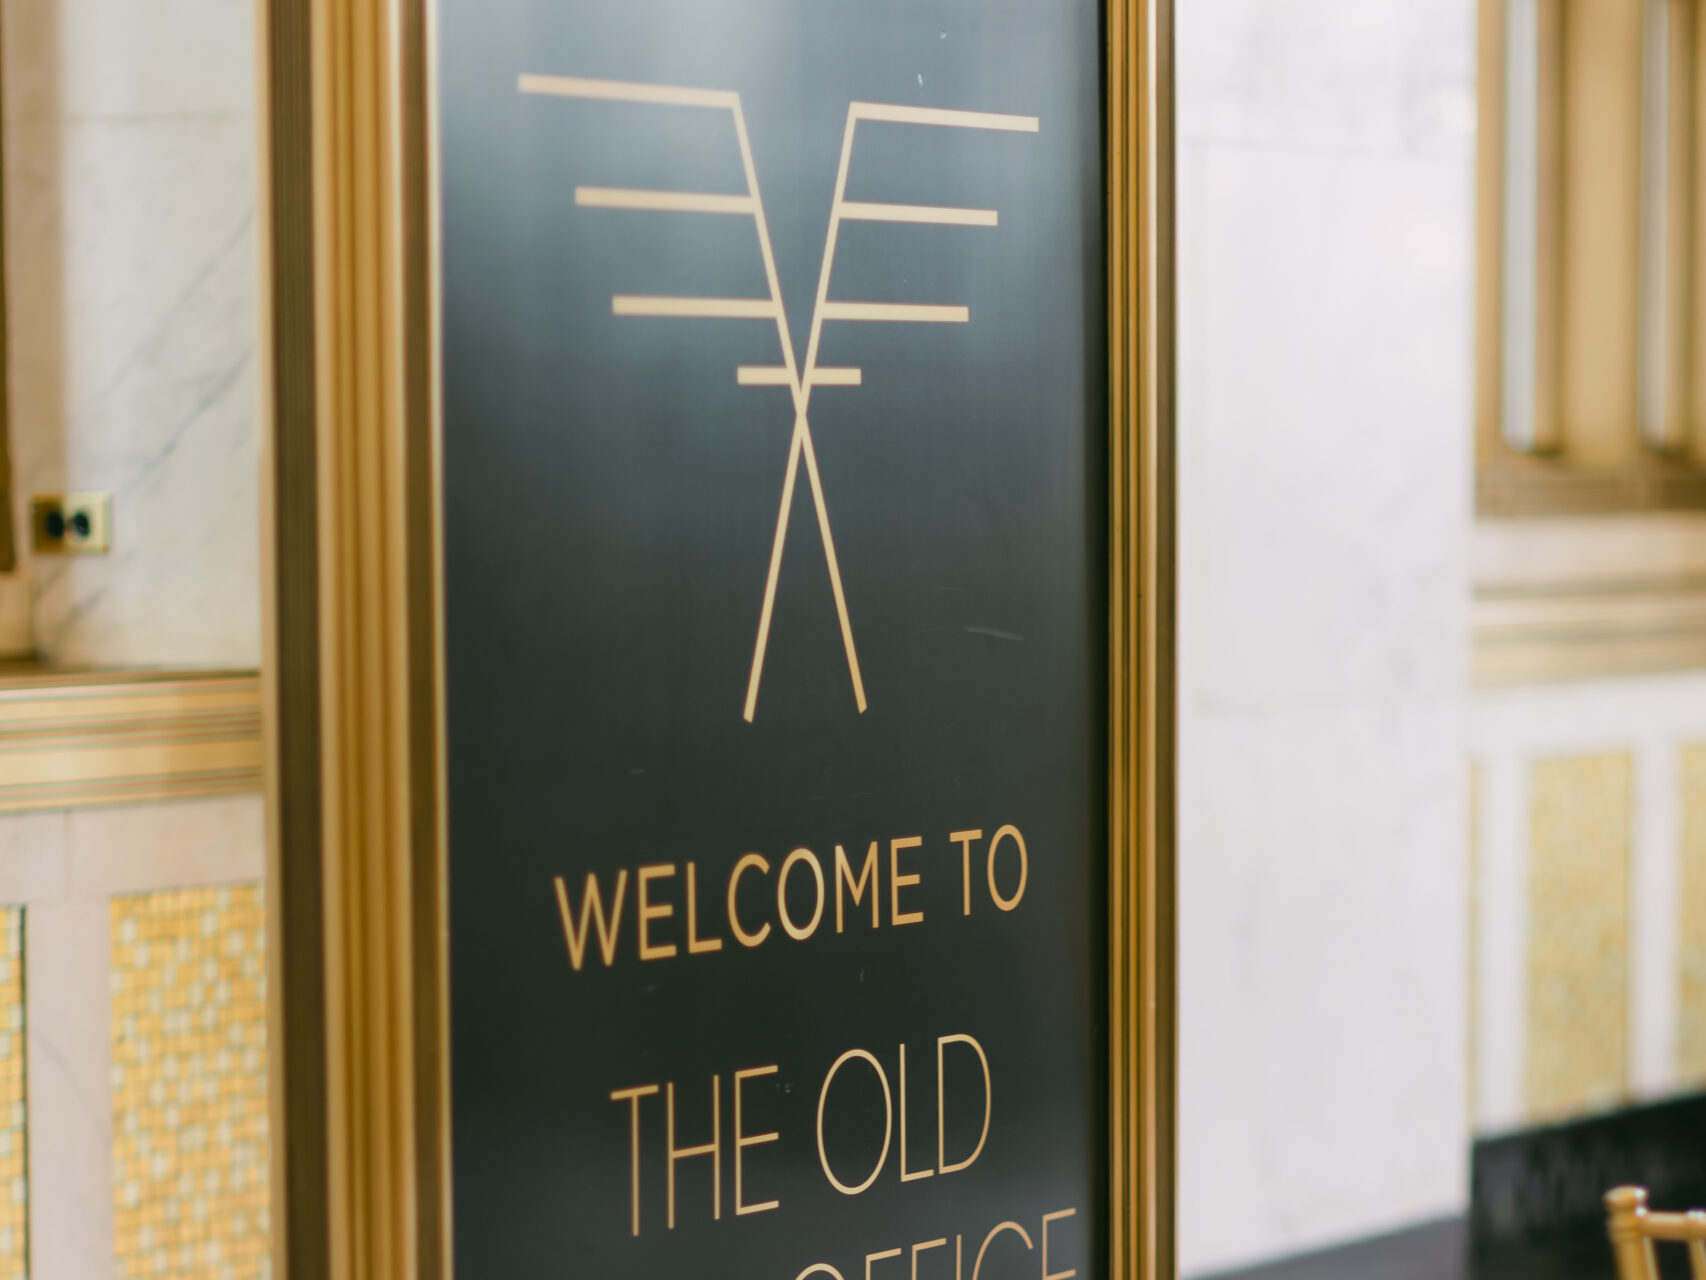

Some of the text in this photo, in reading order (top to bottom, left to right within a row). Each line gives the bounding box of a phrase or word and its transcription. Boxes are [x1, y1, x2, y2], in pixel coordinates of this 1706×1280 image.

[554, 824, 1028, 970] WELCOME TO
[610, 1033, 992, 1236] THE OLD
